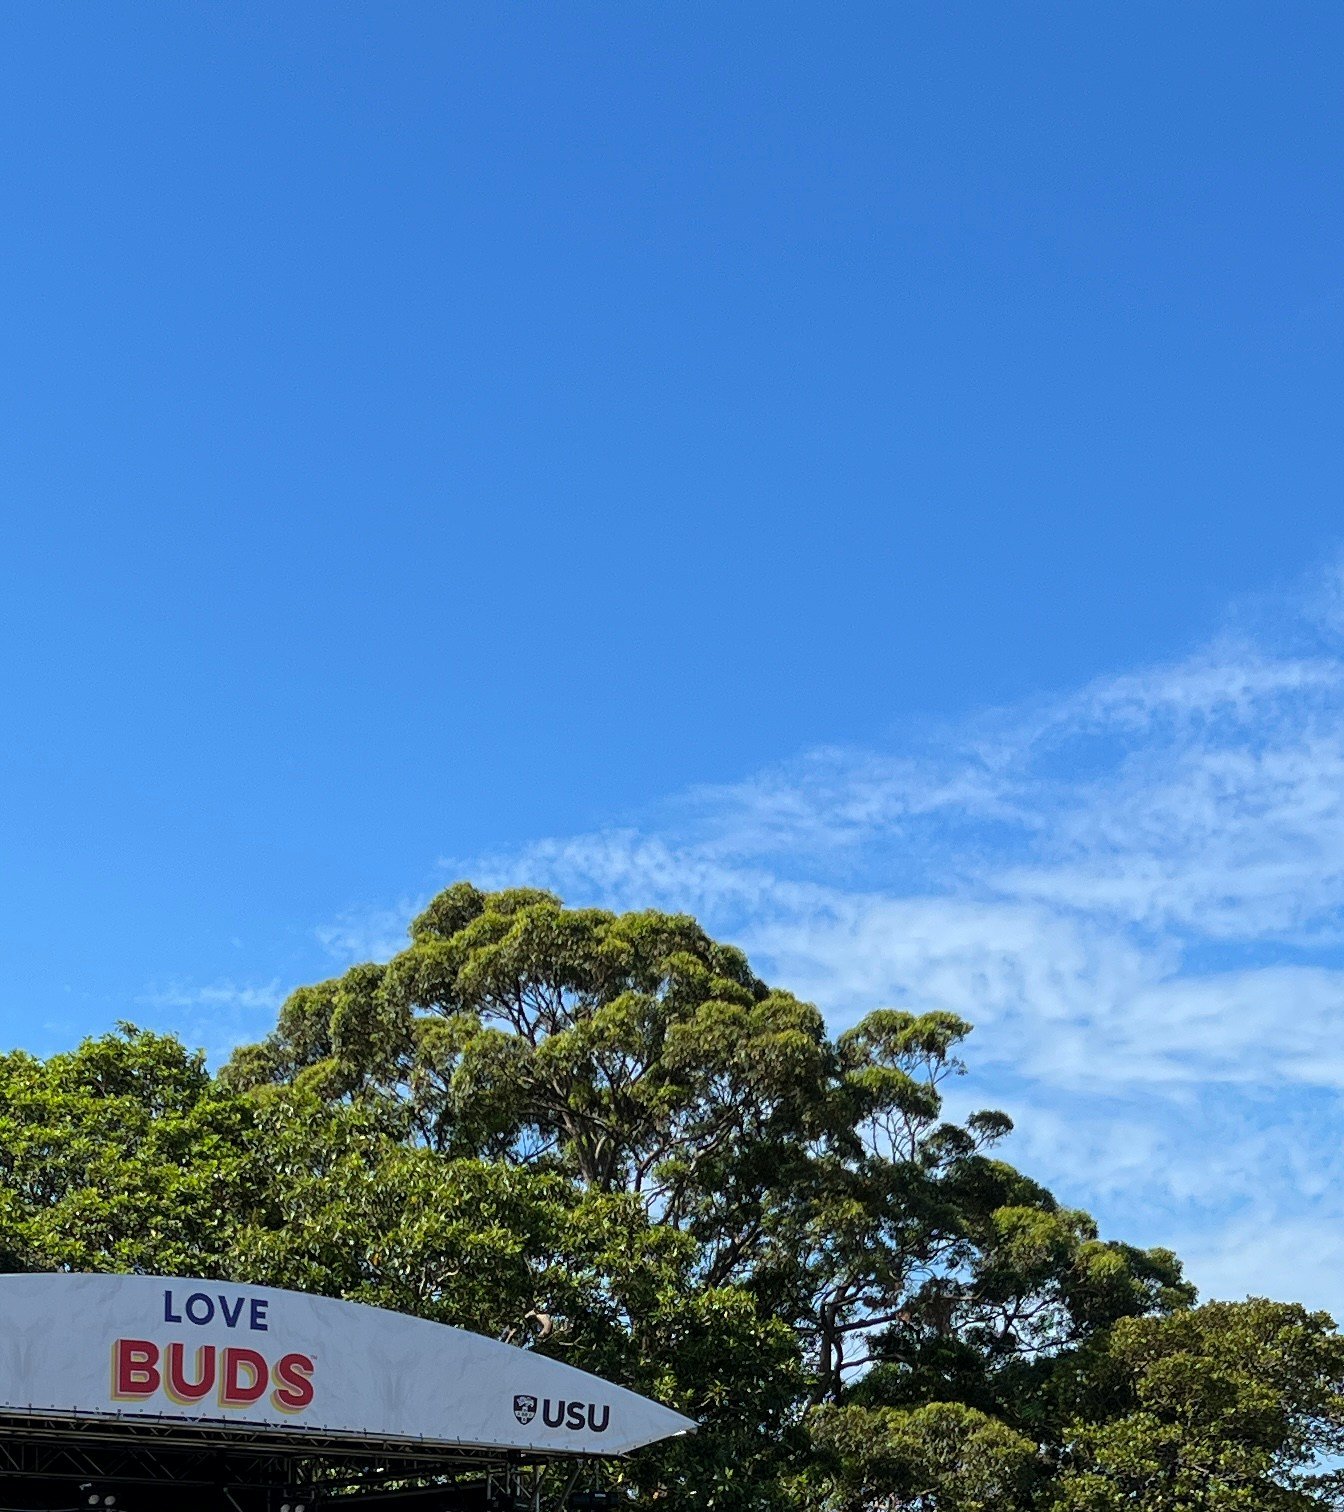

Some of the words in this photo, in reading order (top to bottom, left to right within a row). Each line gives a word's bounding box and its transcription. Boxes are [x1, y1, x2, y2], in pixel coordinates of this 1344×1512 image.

[164, 1290, 269, 1331] LOVE
[111, 1338, 315, 1414] BUDS
[542, 1398, 610, 1433] USU
